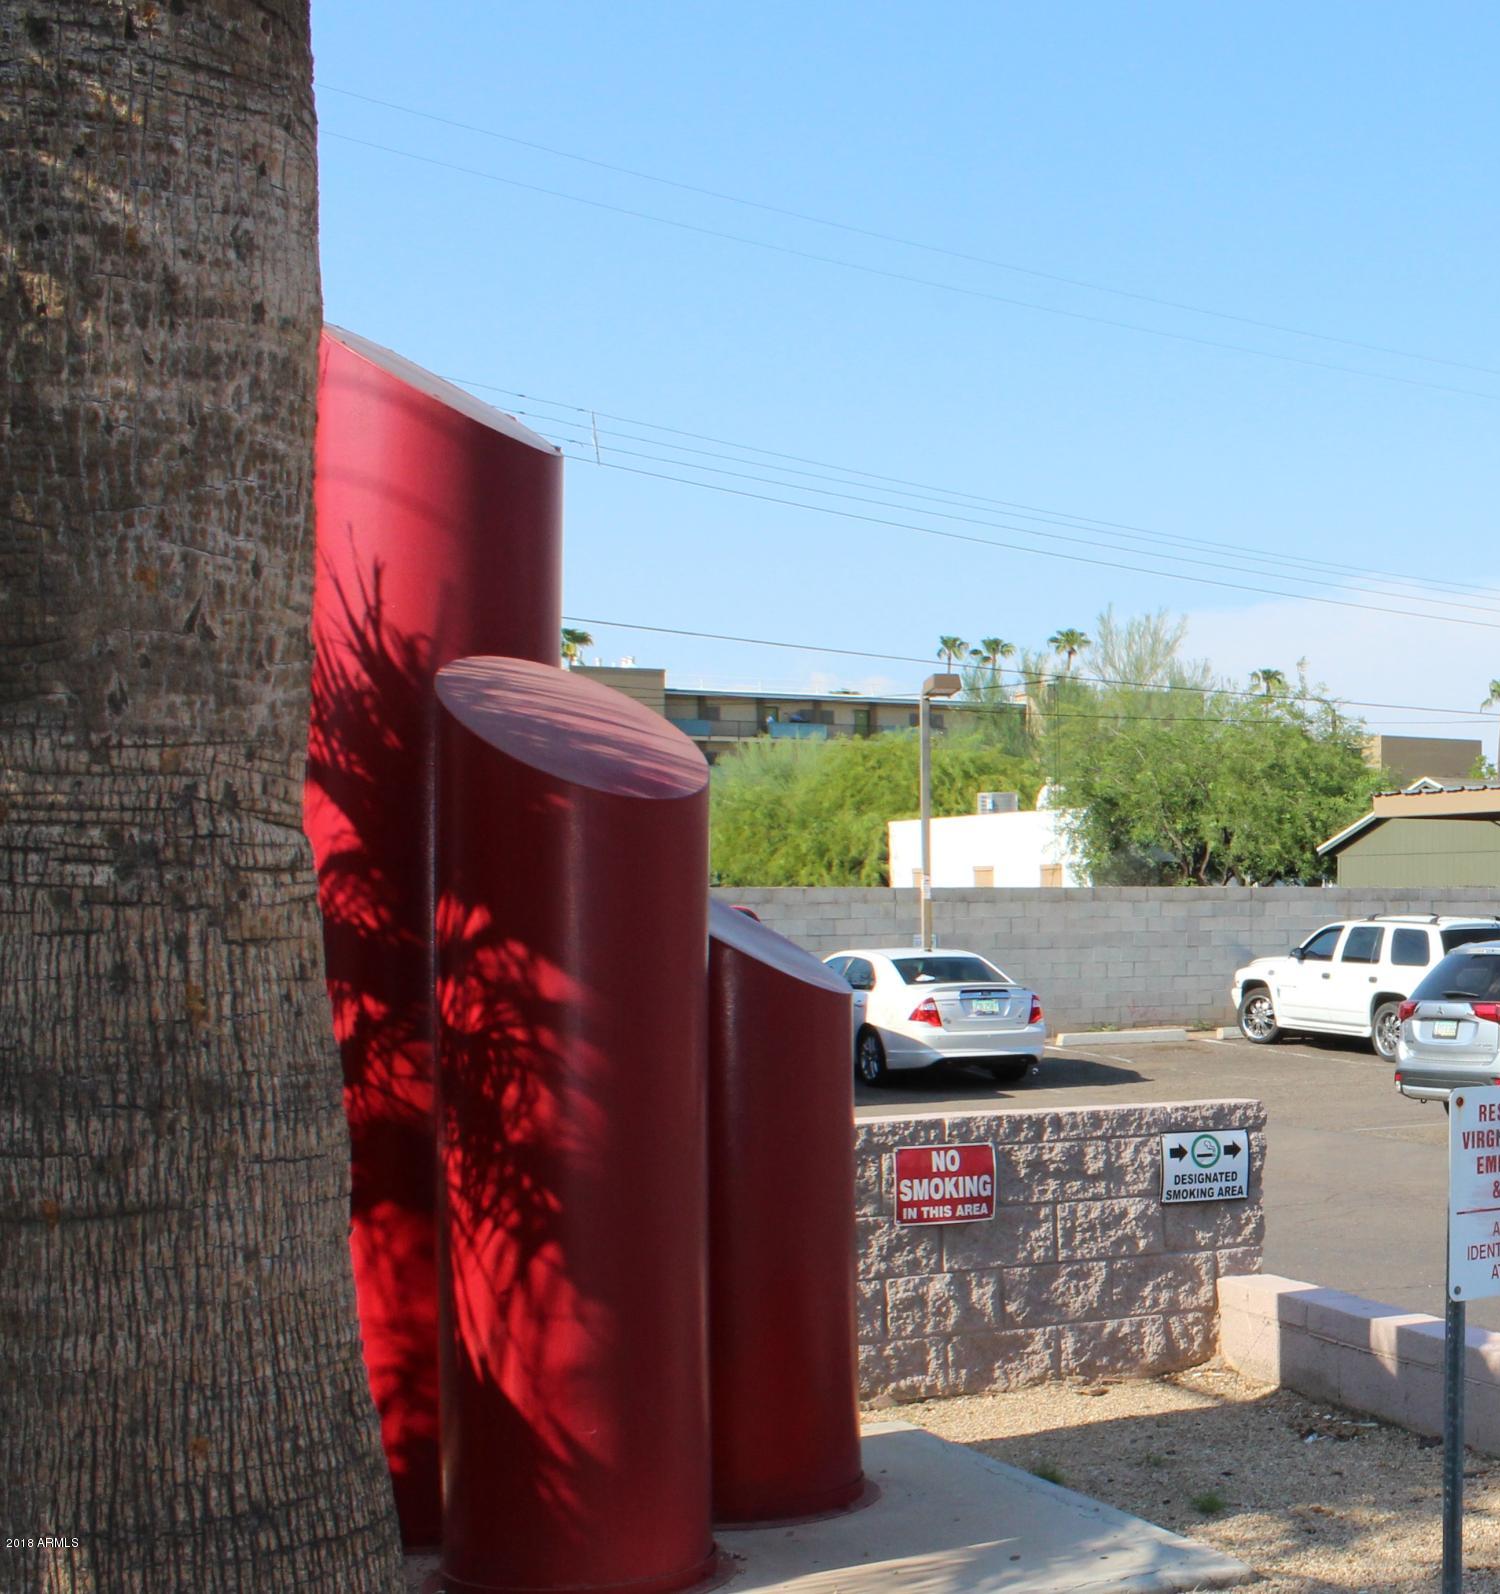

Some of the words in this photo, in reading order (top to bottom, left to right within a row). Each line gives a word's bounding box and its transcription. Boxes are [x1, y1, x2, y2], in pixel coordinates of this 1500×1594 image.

[932, 1149, 960, 1172] NO
[1174, 1171, 1237, 1185] DESIGNATED
[900, 1174, 992, 1202] SMOKING
[1166, 1187, 1214, 1200] SMOKING
[1217, 1185, 1243, 1197] AREA
[903, 1207, 917, 1220] IN
[921, 1205, 952, 1218] THIS
[956, 1202, 988, 1216] AREA
